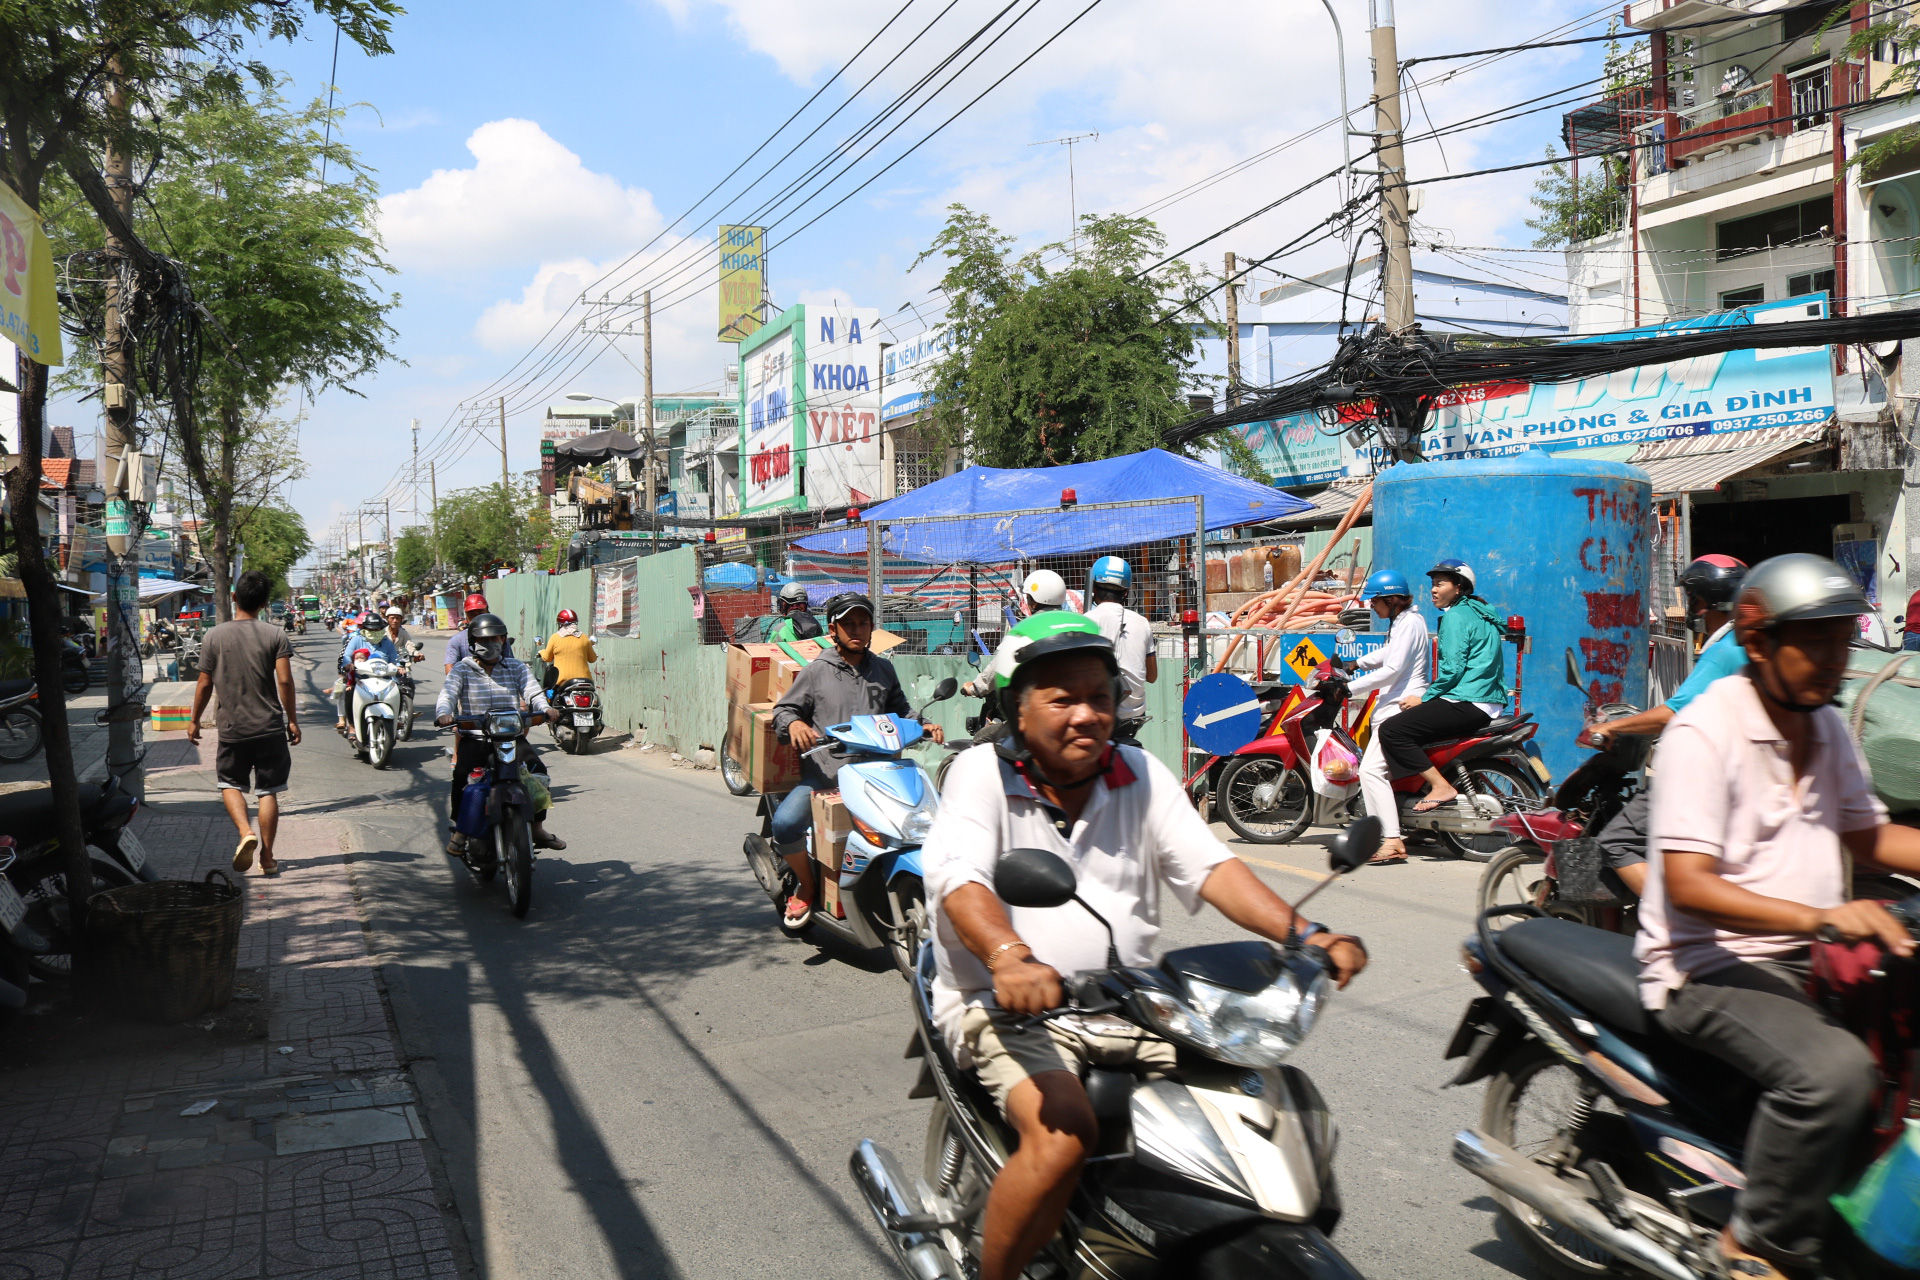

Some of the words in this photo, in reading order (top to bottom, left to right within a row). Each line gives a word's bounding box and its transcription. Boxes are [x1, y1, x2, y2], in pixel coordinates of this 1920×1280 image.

[727, 230, 754, 247] NHA
[722, 252, 758, 271] KHOA
[721, 275, 759, 312] VIỆT
[813, 364, 870, 391] KHOA
[809, 402, 876, 451] VIỆT
[1523, 412, 1617, 437] PHÒNG
[1627, 408, 1650, 425] &
[1660, 400, 1714, 420] GIA
[1725, 385, 1813, 413] ĐÌNH
[1577, 434, 1599, 447] ĐT:
[1604, 424, 1695, 444] 08.62780706
[1712, 408, 1826, 432] 0937.250.266
